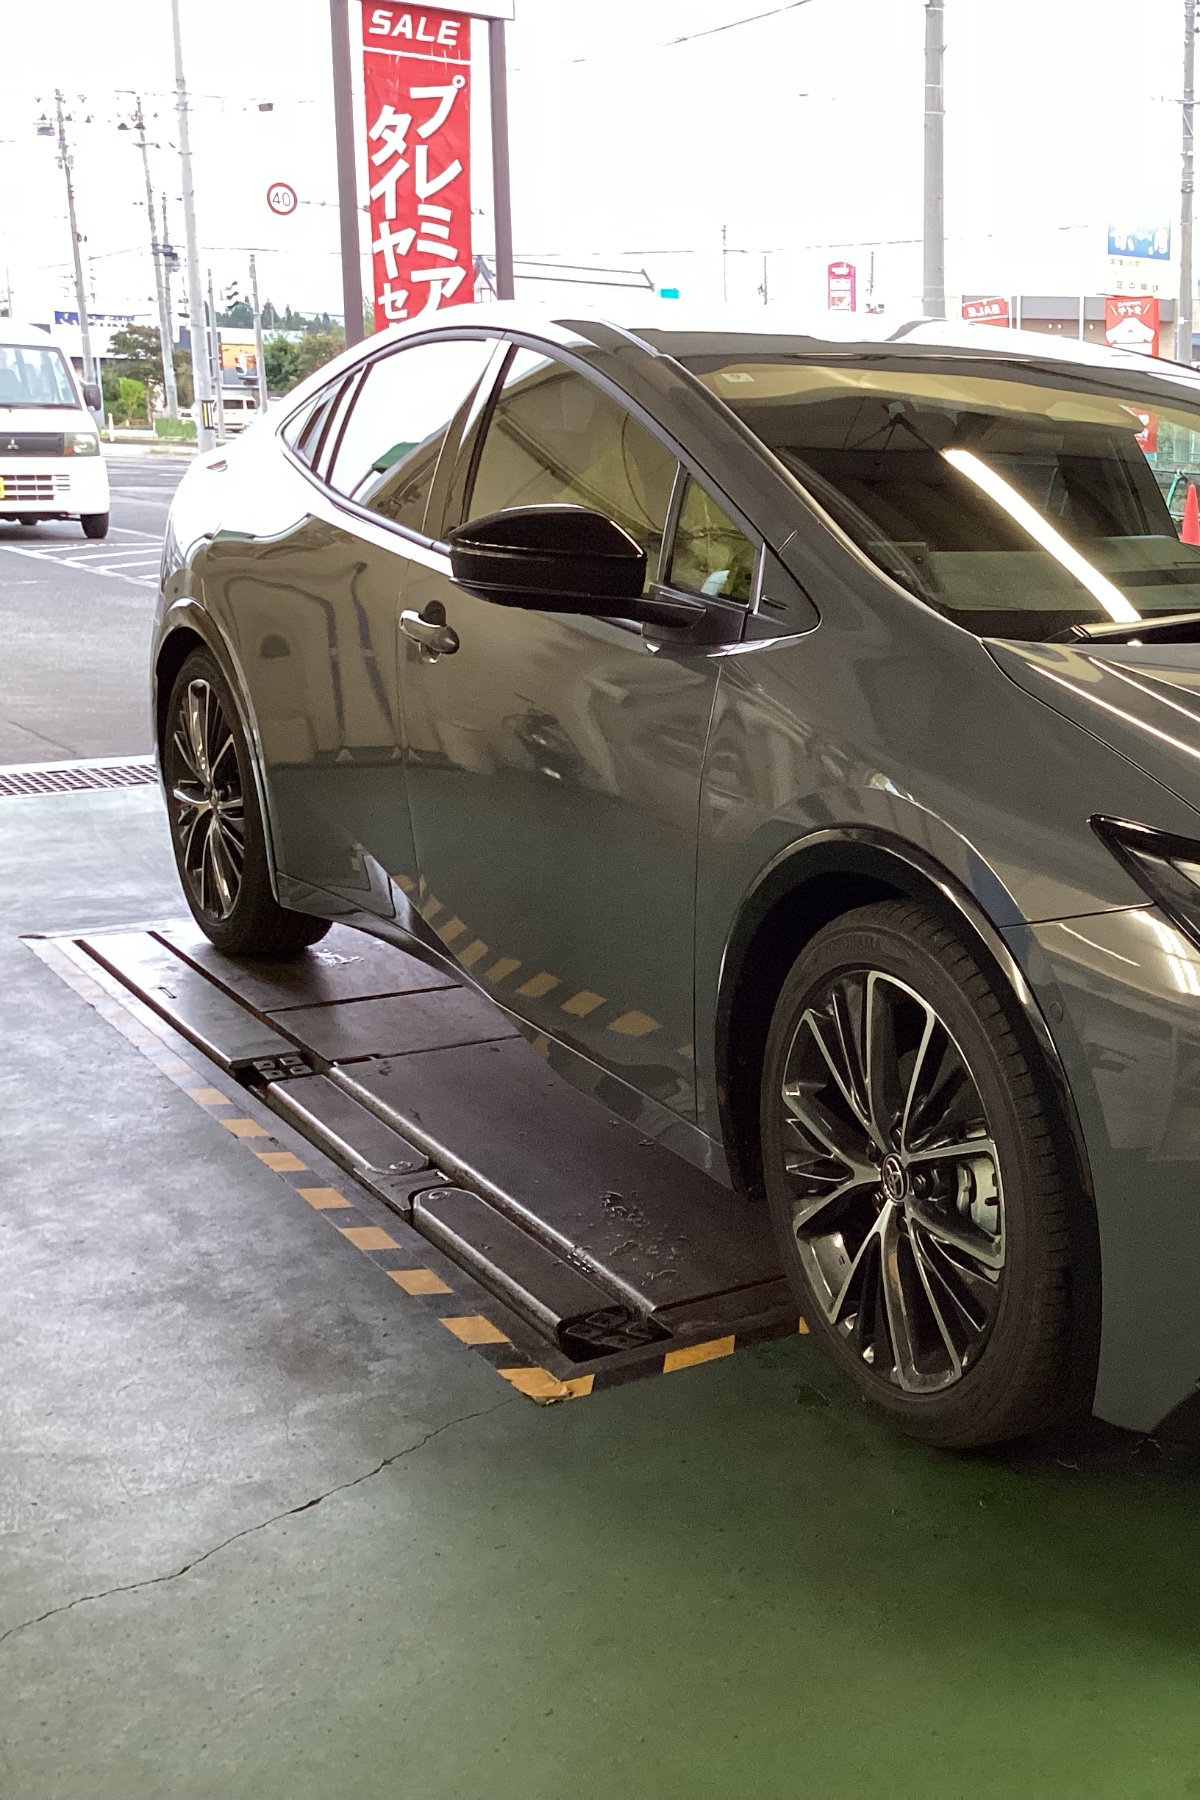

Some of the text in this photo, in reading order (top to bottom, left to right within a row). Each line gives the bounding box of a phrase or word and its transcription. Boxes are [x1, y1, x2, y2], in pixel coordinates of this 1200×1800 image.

[368, 9, 461, 46] SALE
[273, 192, 290, 206] 40
[368, 104, 416, 328] タイヤセ
[410, 75, 466, 317] プレミア
